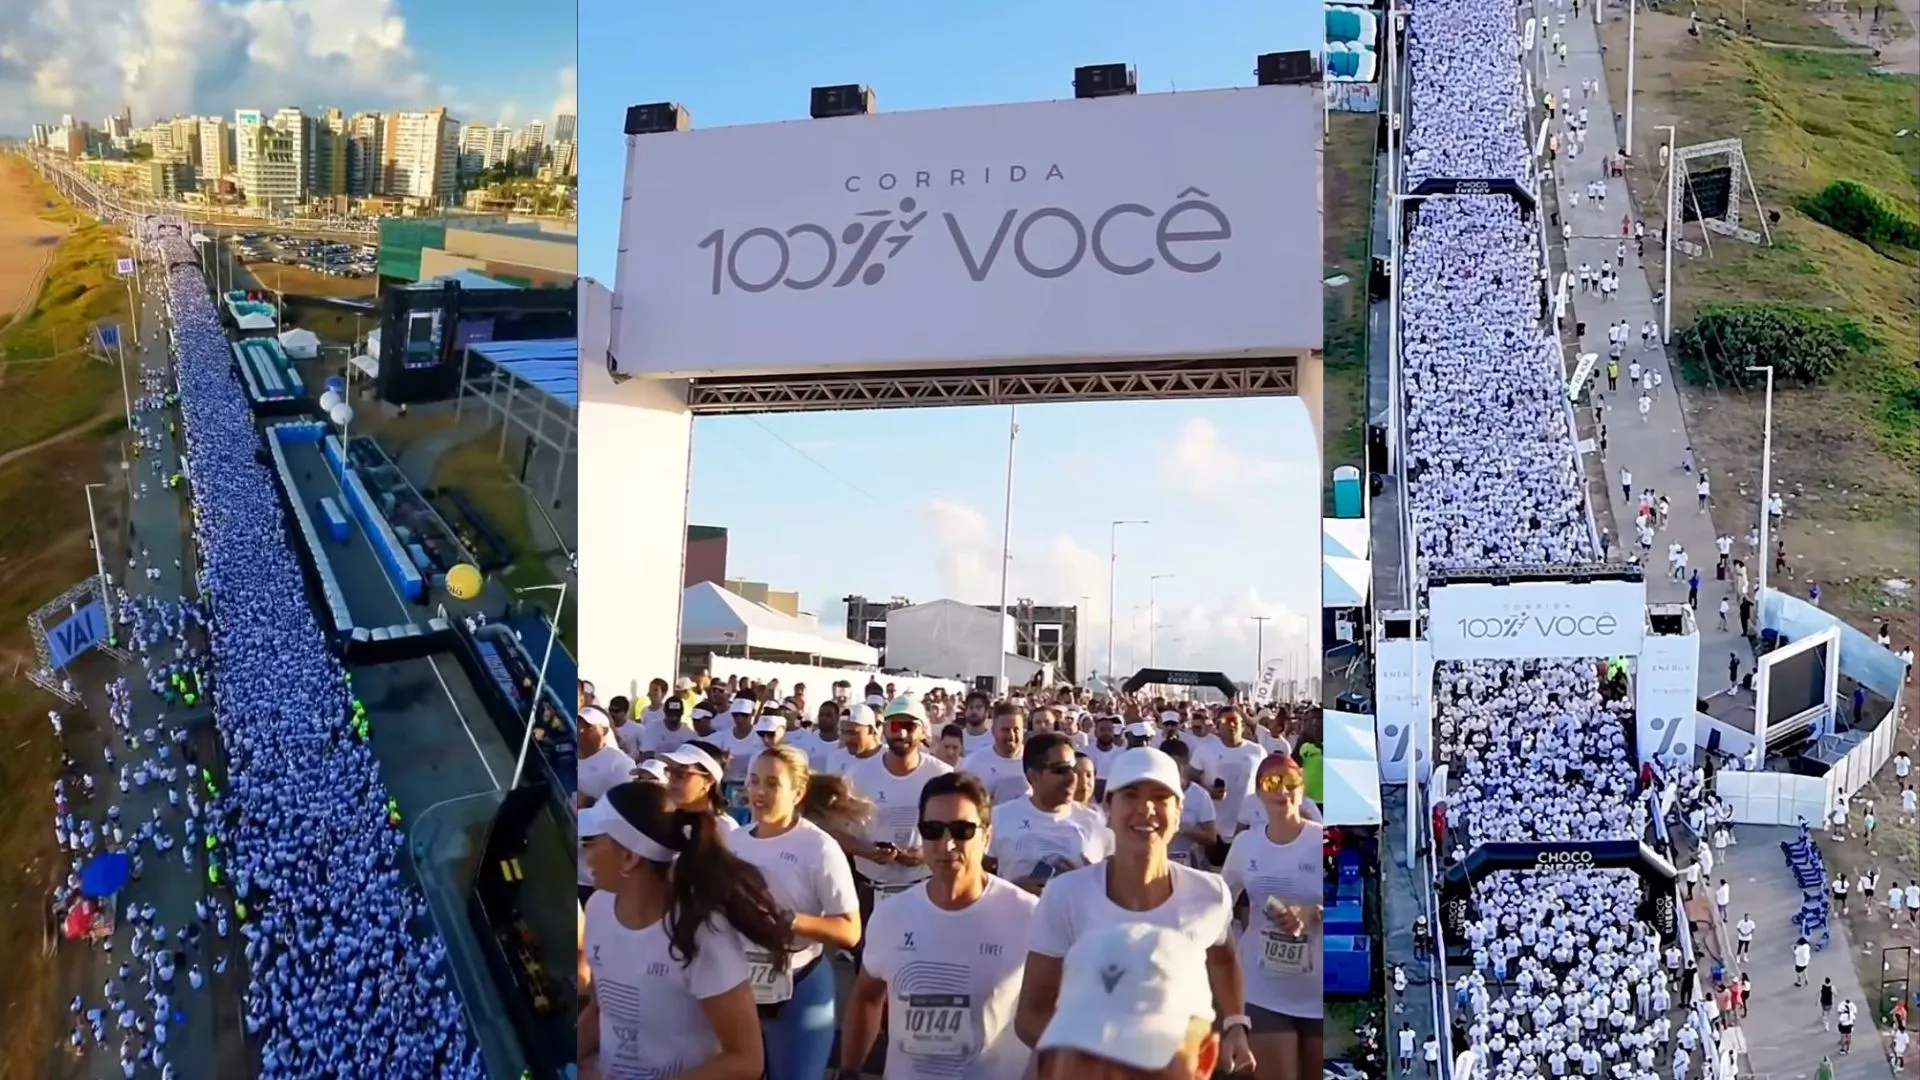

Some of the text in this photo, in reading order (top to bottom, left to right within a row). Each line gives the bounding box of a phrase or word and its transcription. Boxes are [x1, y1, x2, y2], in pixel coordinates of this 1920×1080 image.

[844, 164, 1065, 193] CORRIDA
[56, 611, 95, 657] VAI
[1537, 850, 1593, 864] CHOCO
[1448, 900, 1458, 928] HOCO
[1664, 894, 1673, 934] ENERGY
[1264, 941, 1304, 960] 10361
[904, 1009, 963, 1034] 10144
